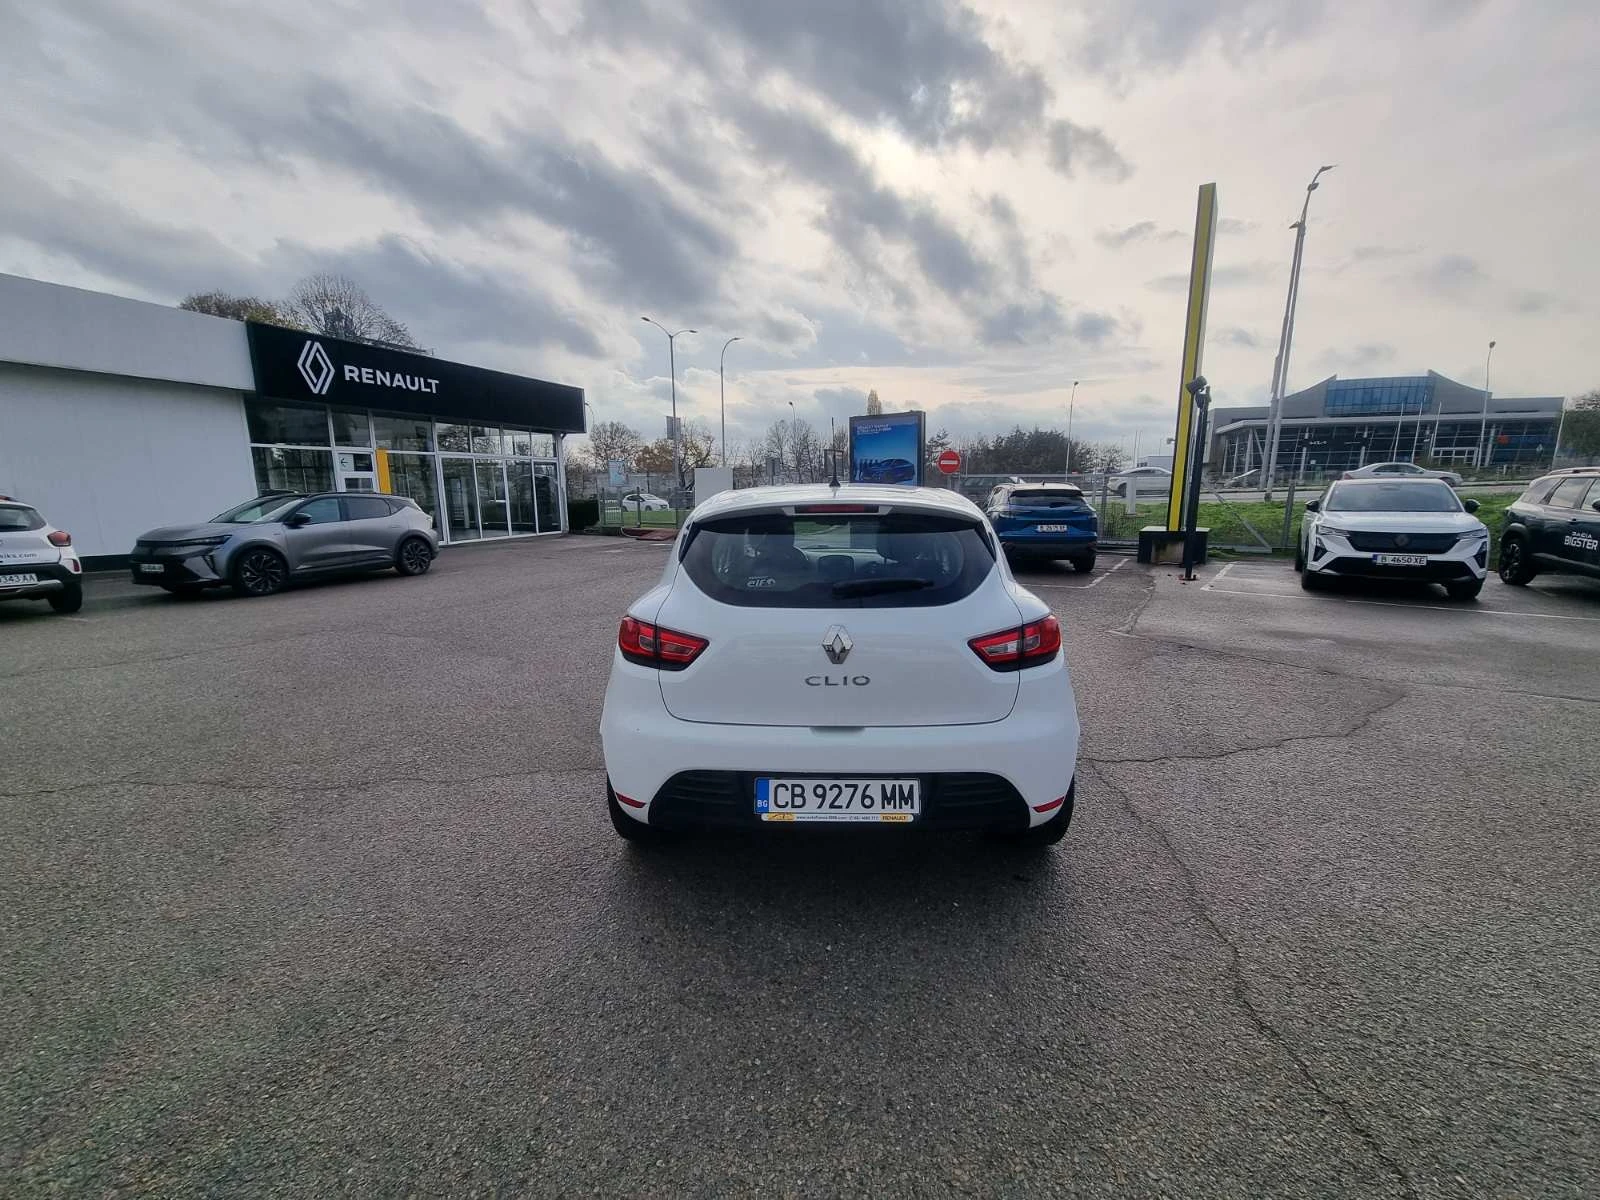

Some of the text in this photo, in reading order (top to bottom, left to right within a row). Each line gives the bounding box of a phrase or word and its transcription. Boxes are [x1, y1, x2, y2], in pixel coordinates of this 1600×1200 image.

[344, 365, 439, 394] RENAULT
[1564, 535, 1599, 550] BIGSTER
[805, 676, 870, 686] CLIO
[773, 783, 914, 809] CB 9276 MM
[757, 800, 768, 808] BG
